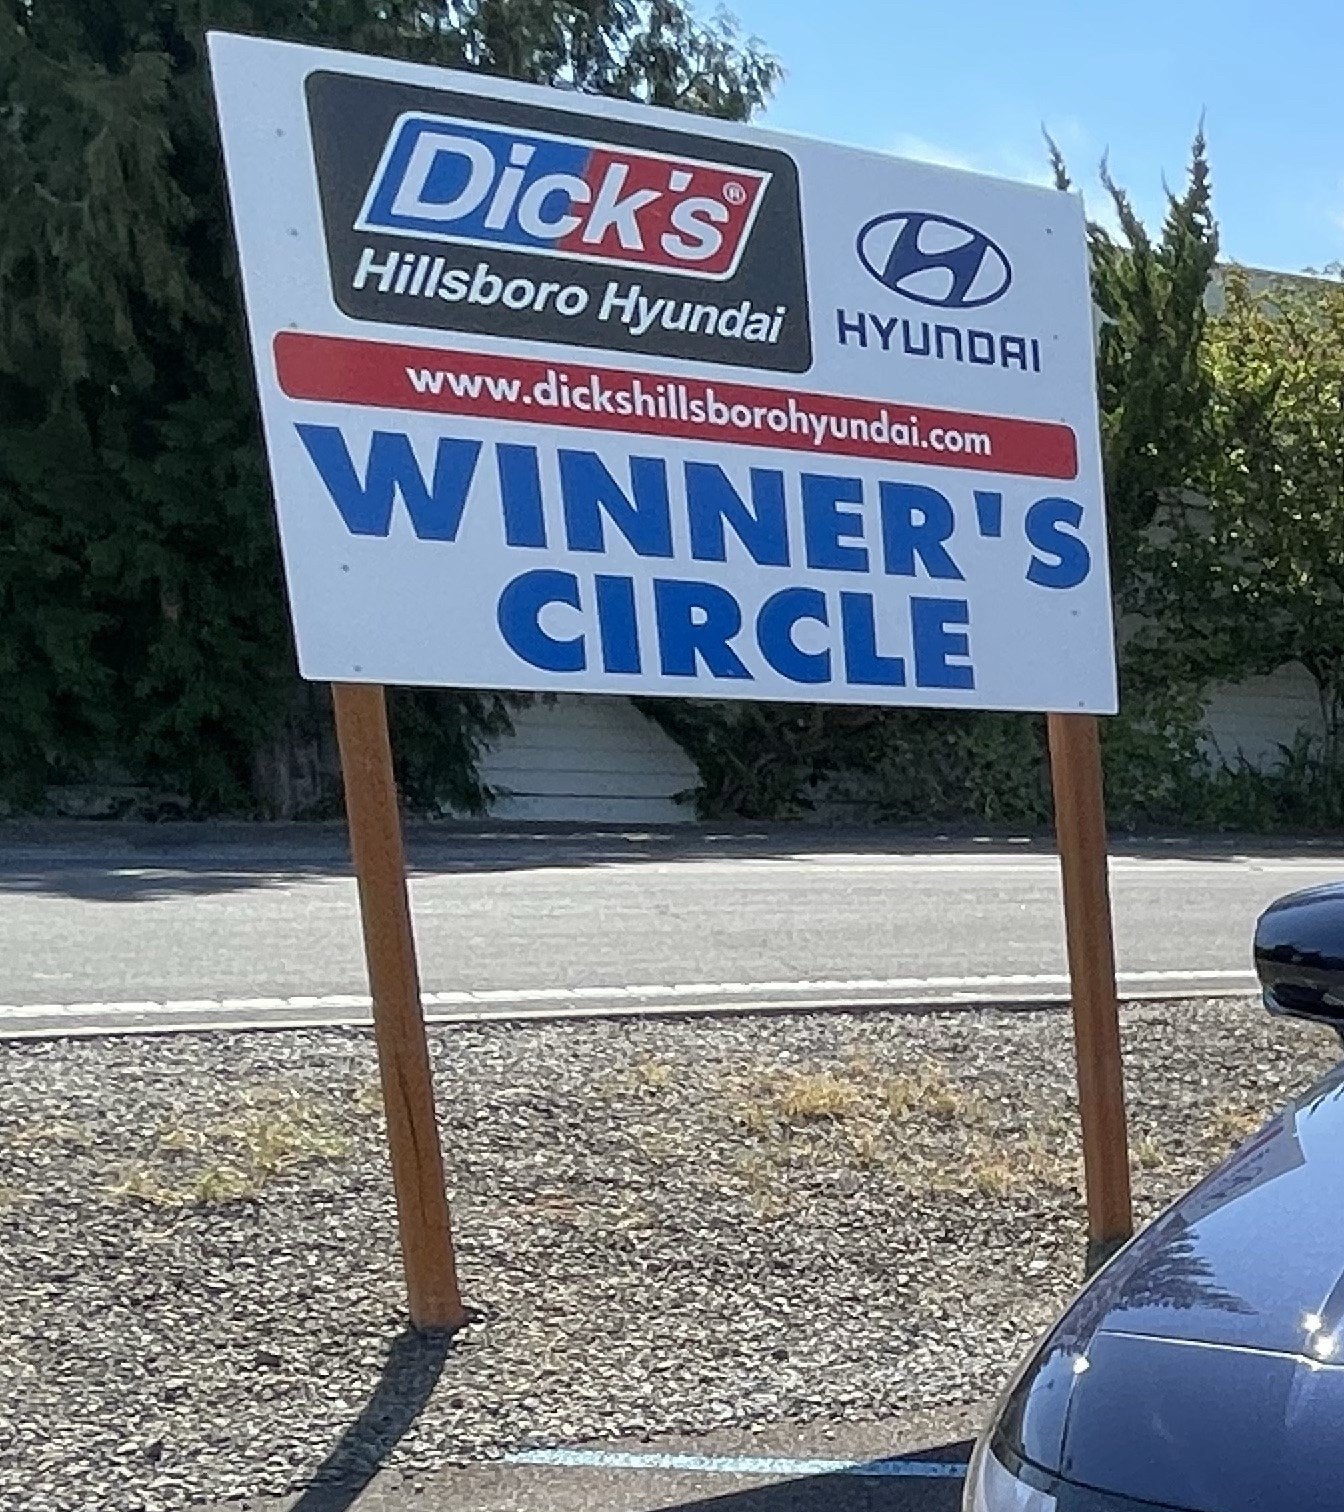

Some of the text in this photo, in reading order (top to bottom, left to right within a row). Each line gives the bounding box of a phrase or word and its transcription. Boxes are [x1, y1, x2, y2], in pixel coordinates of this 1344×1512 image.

[389, 129, 730, 263] Dick's
[352, 248, 787, 346] Hillsboro Hyundai
[838, 307, 1041, 373] HYUNDAI
[405, 362, 993, 457] www.dickshillsborohyundai.com
[294, 422, 1091, 589] WINNER'S
[497, 569, 976, 690] CIRCLE
